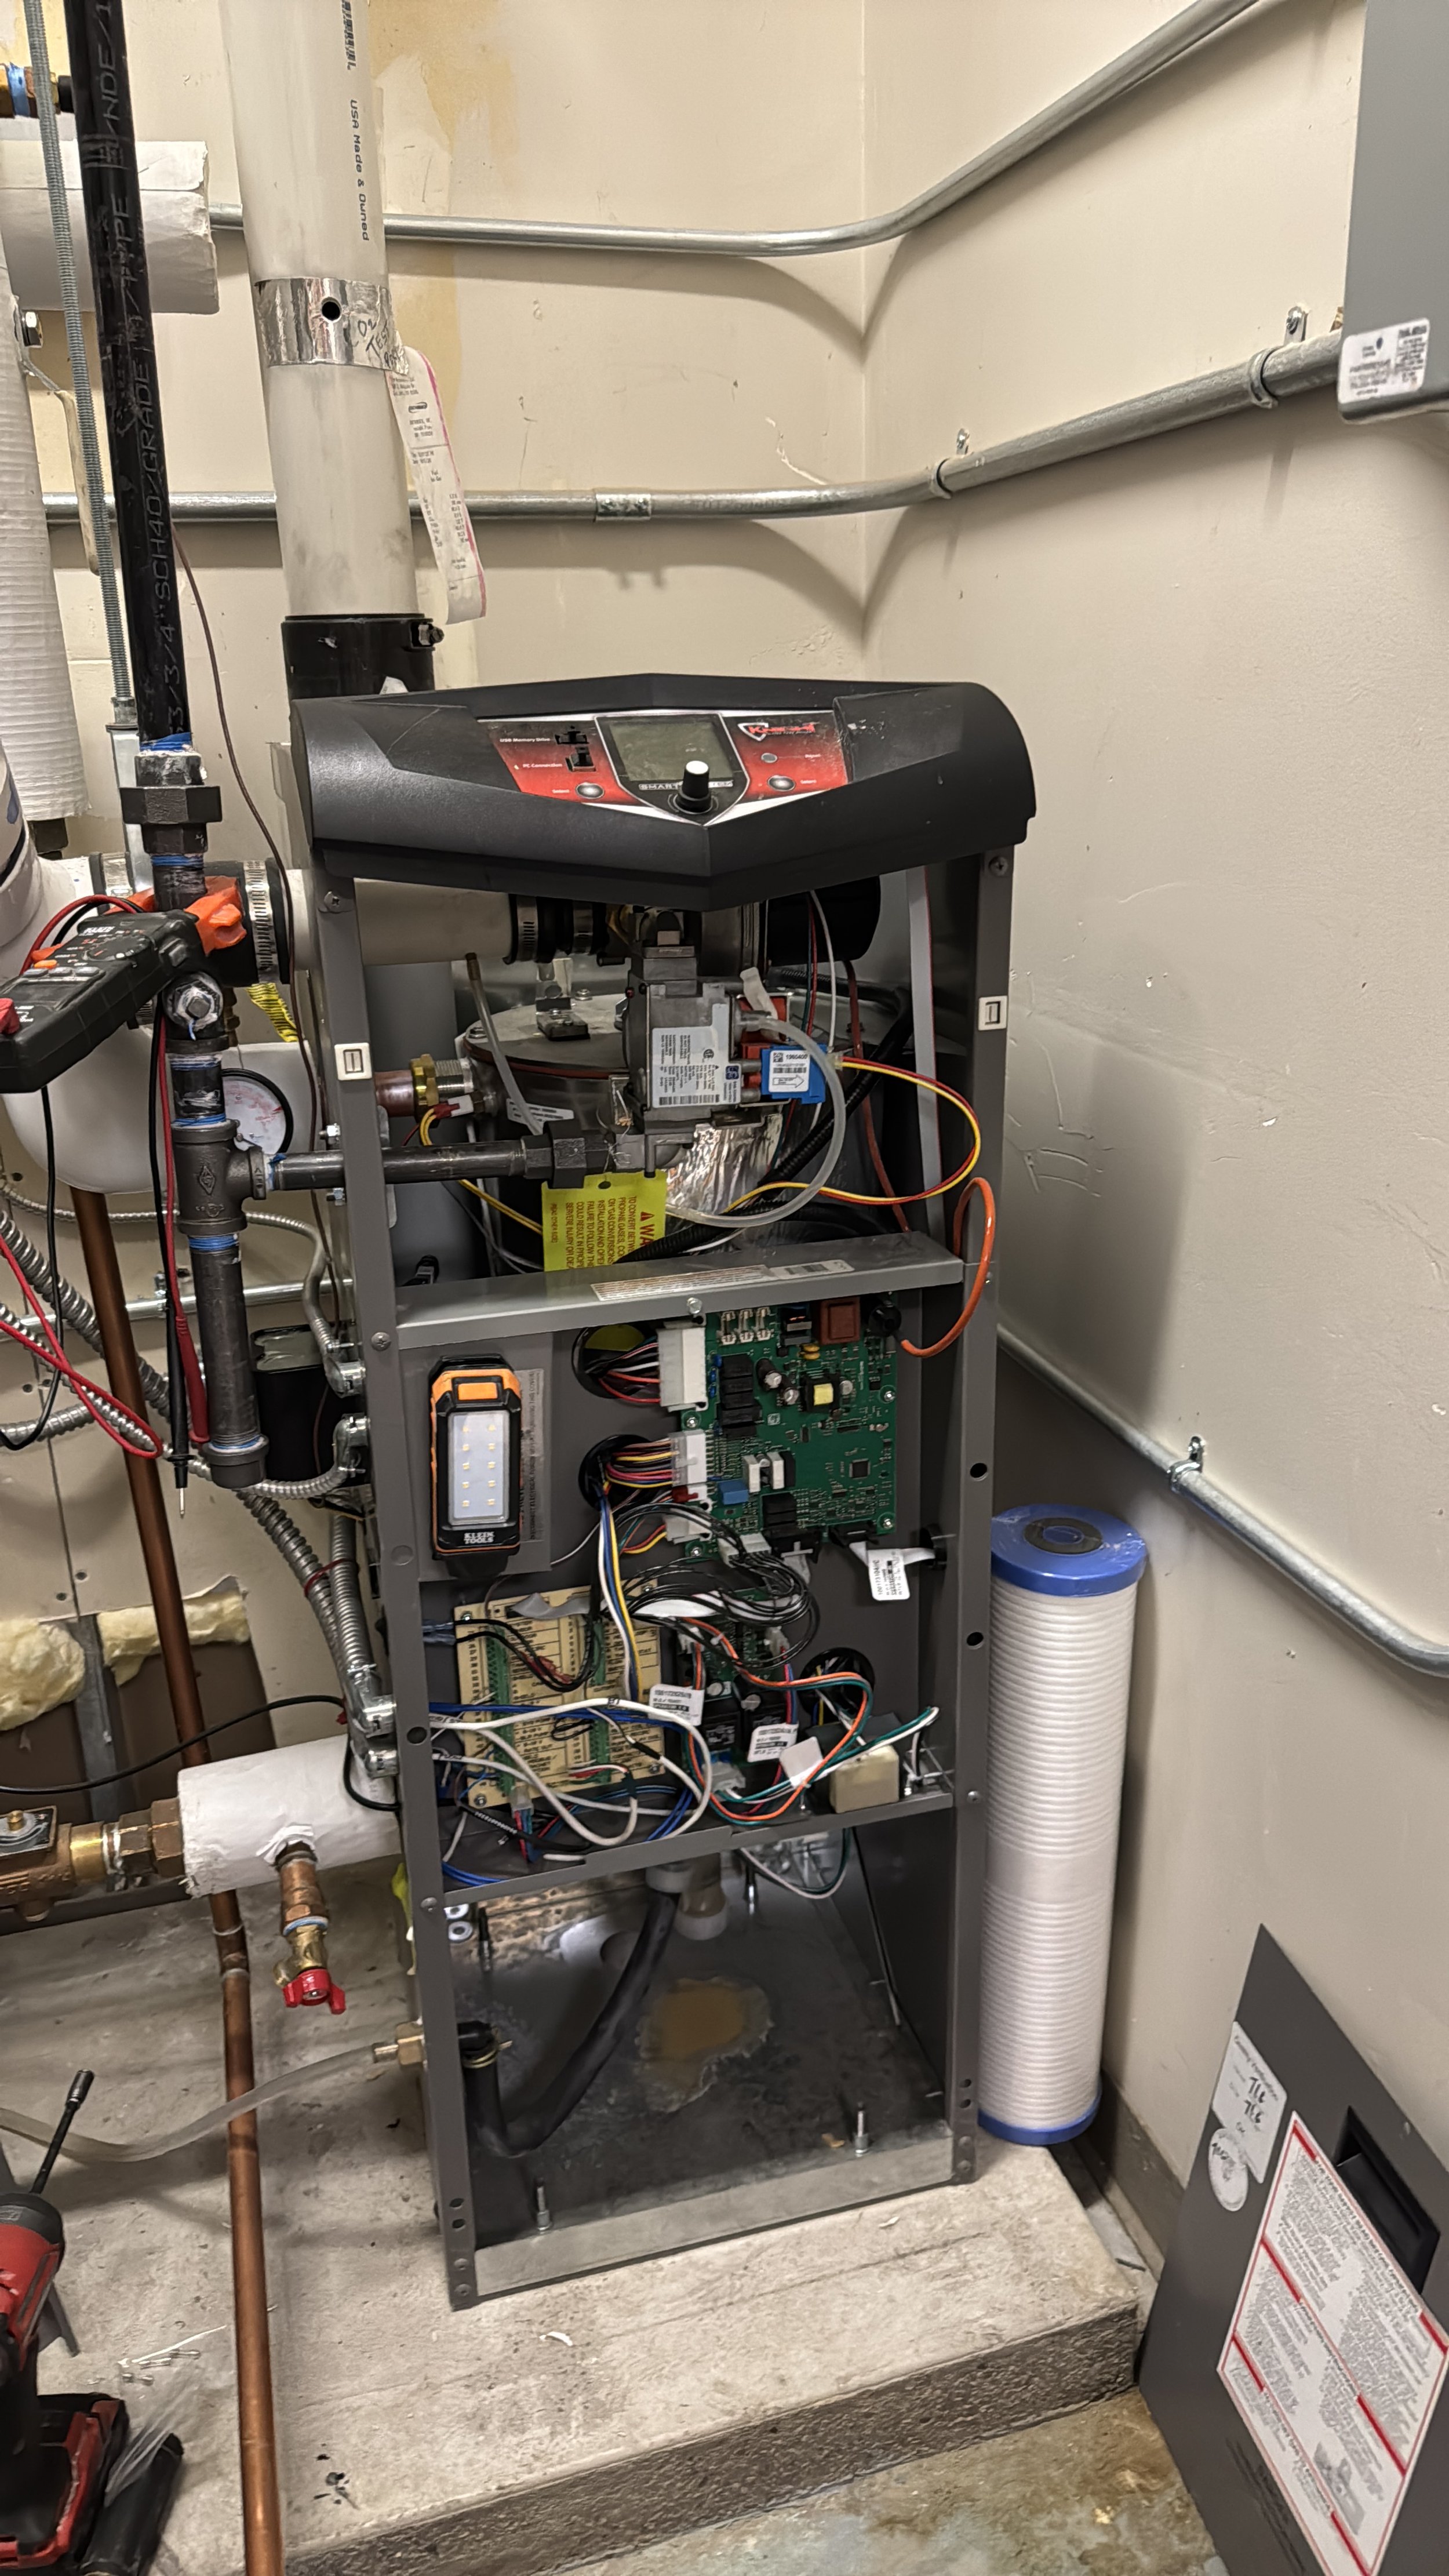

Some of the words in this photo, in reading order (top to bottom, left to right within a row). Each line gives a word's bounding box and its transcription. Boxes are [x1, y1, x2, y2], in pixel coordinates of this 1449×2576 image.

[350, 99, 359, 129] USA
[353, 134, 363, 173] Made
[357, 178, 365, 188] &
[358, 193, 370, 241] Owned
[576, 1201, 584, 1218] COULD
[618, 1197, 627, 1222] PROPANE
[628, 1195, 637, 1203] TO
[587, 1200, 595, 1222] FAILURE
[597, 1200, 605, 1235] INSTALLATION
[628, 1204, 637, 1231] CONVERT
[566, 1226, 574, 1245] INJURY
[576, 1220, 584, 1239] RESULT
[640, 1224, 655, 1247] WA
[566, 1246, 574, 1256] OR
[586, 1231, 595, 1254] FOLLOW
[597, 1235, 605, 1247] AND
